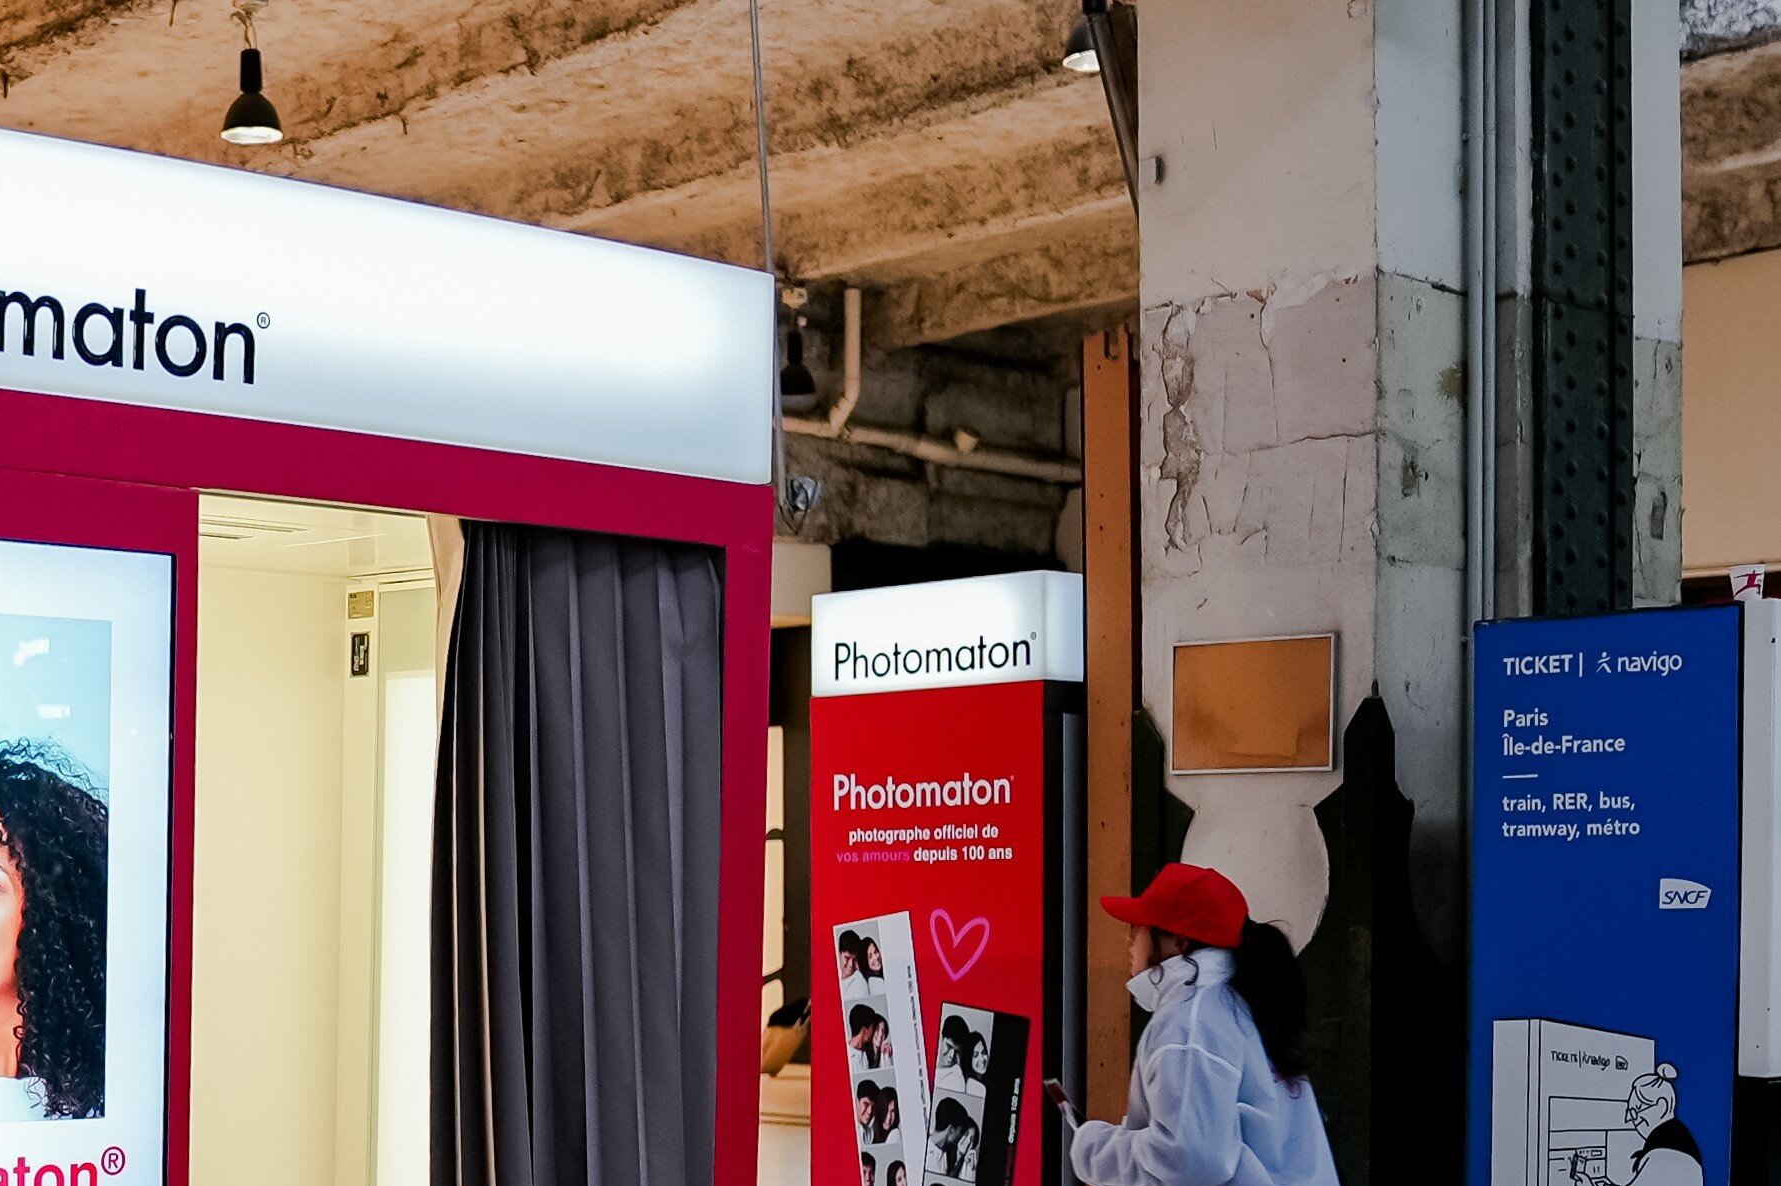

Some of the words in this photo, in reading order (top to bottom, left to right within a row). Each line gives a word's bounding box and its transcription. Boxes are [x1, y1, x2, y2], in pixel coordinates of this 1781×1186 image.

[1503, 654, 1573, 676] TICKET
[1617, 651, 1682, 677] navigo
[1503, 708, 1548, 727] Paris
[1502, 733, 1625, 756] Île-de-France
[1502, 794, 1546, 813] train,
[1552, 793, 1593, 813] RER,
[1599, 791, 1635, 811] bus,
[848, 826, 930, 846] photographe
[933, 824, 978, 840] officiel
[982, 823, 999, 838] de
[1502, 821, 1580, 841] tramway,
[1586, 819, 1640, 836] métro
[836, 852, 859, 862] vos
[862, 850, 910, 863] amours
[913, 846, 958, 864] depuis
[962, 845, 985, 860] 100
[988, 847, 1013, 860] ans
[1661, 890, 1707, 905] SNCF
